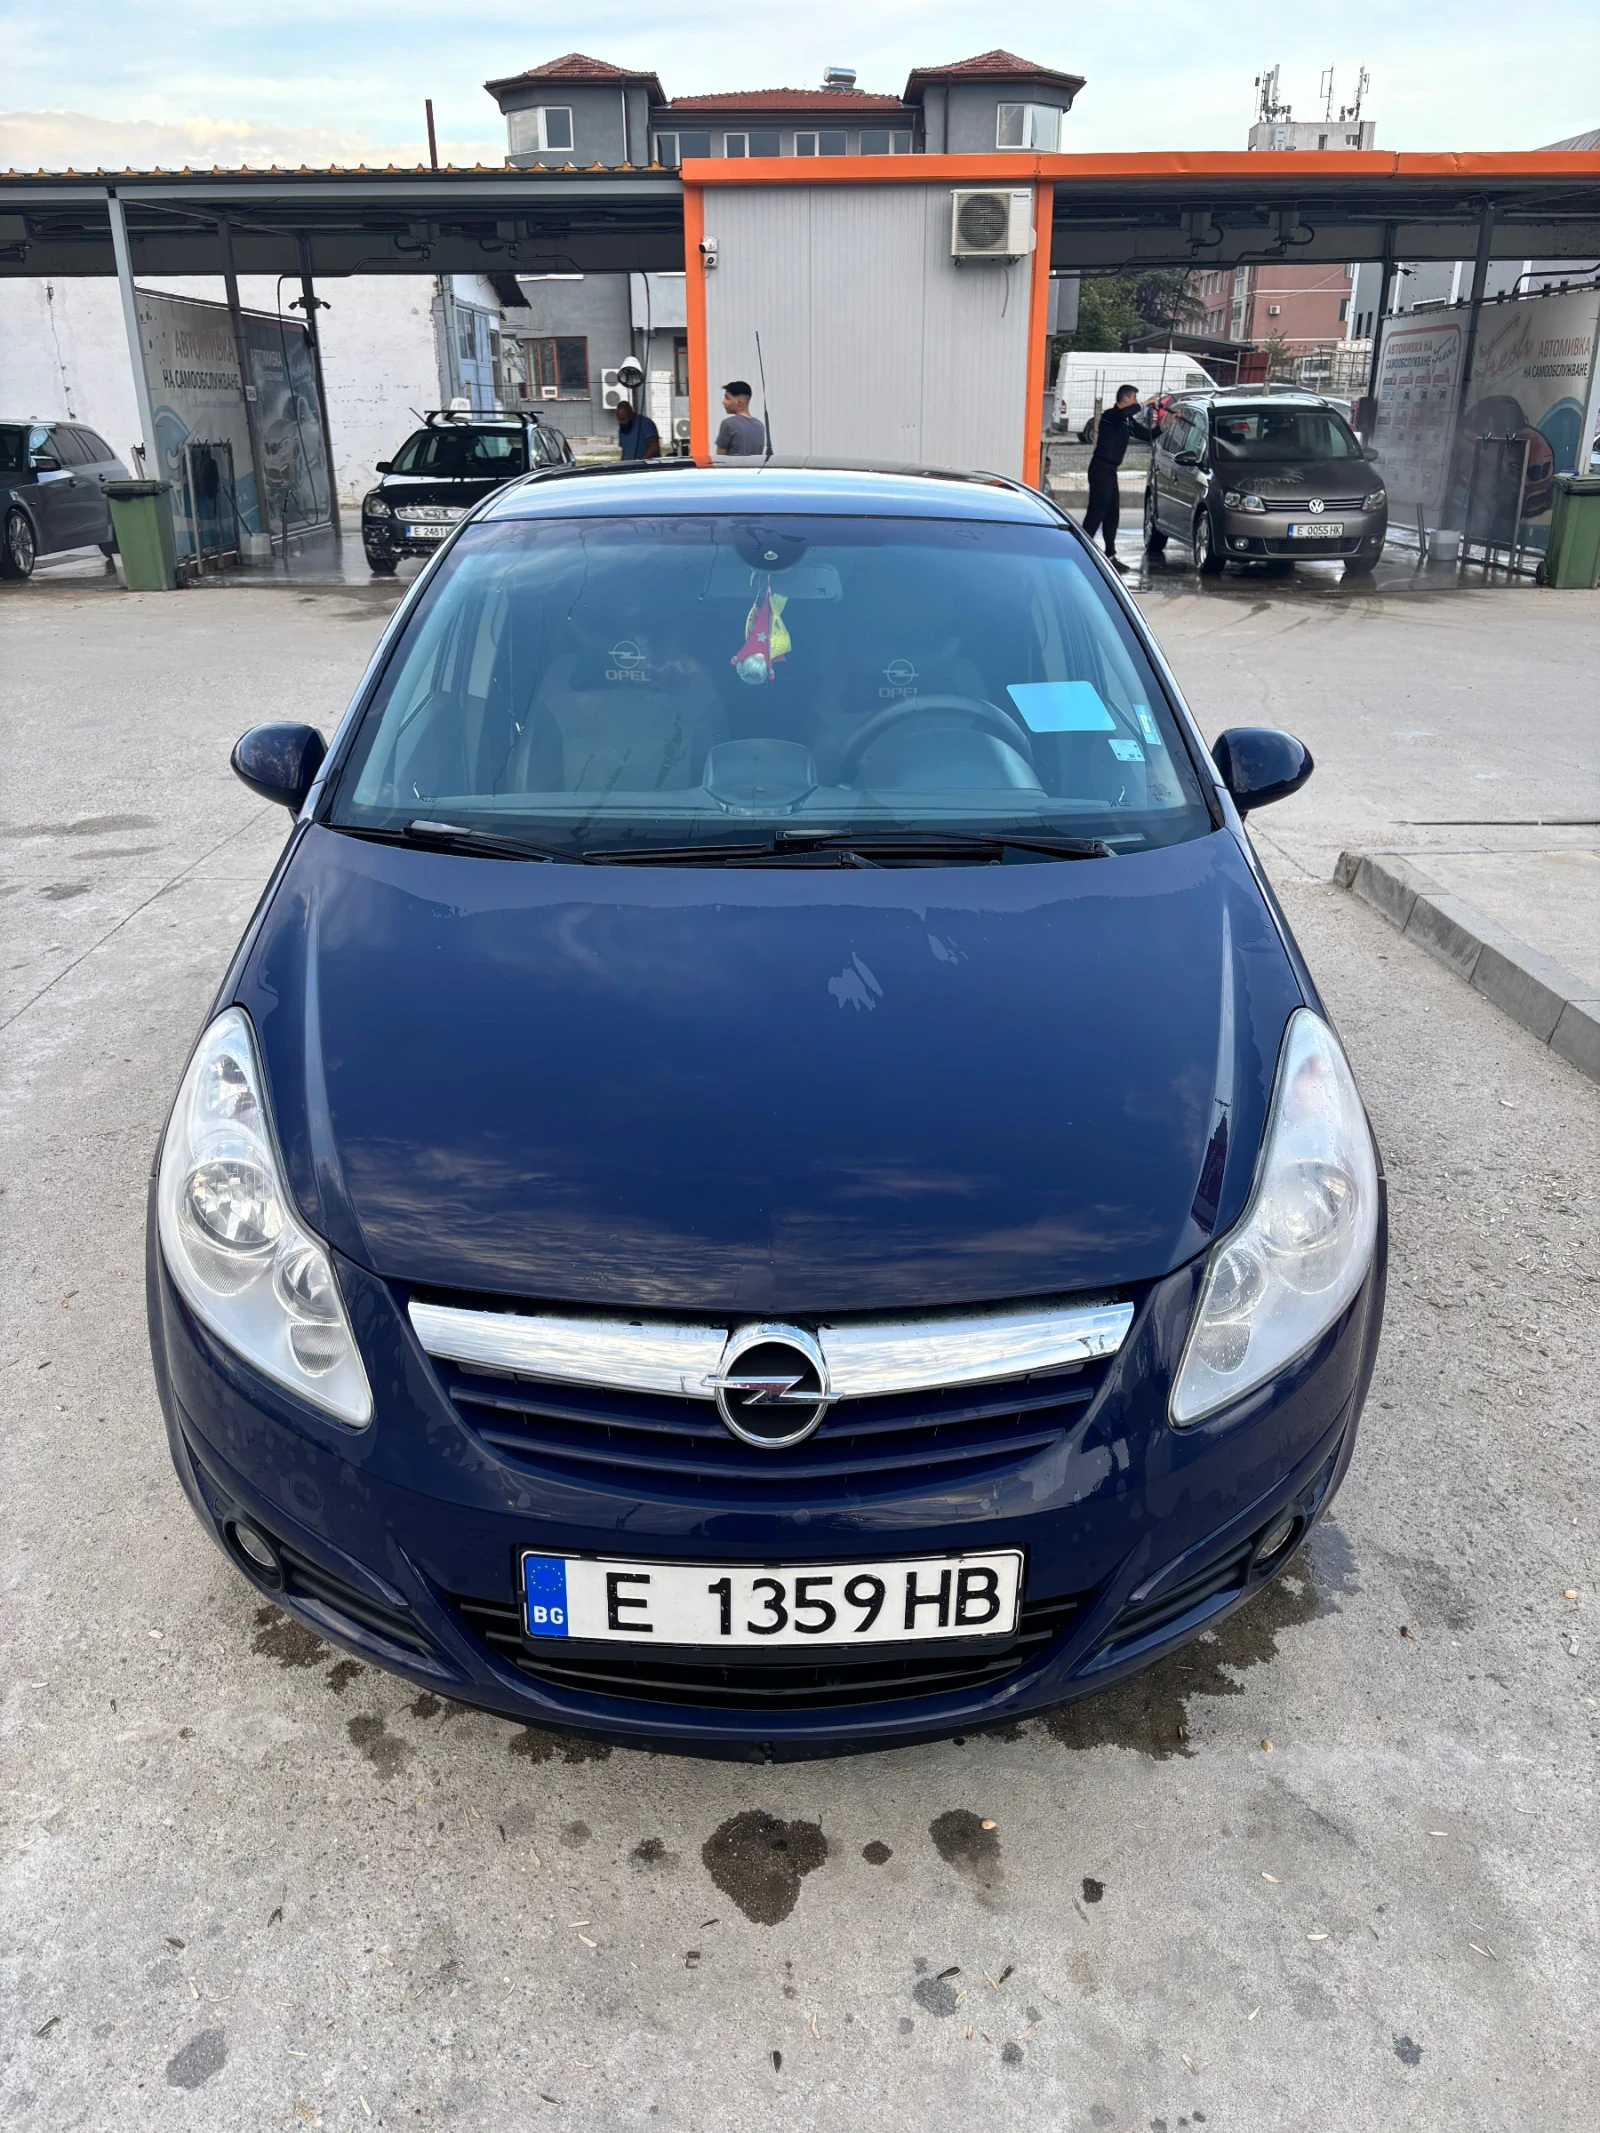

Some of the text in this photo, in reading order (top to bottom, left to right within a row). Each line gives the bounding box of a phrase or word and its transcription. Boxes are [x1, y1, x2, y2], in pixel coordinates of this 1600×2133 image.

[1387, 341, 1433, 355] АВТОМИВКА НА
[1538, 337, 1591, 358] АВТОМИВКА
[162, 369, 175, 389] НА
[1523, 368, 1532, 378] НА
[414, 527, 421, 536] E
[1297, 526, 1304, 535] E
[605, 669, 651, 681] OPEL
[606, 1566, 1001, 1636] E 1359 HB
[533, 1605, 564, 1625] BG
